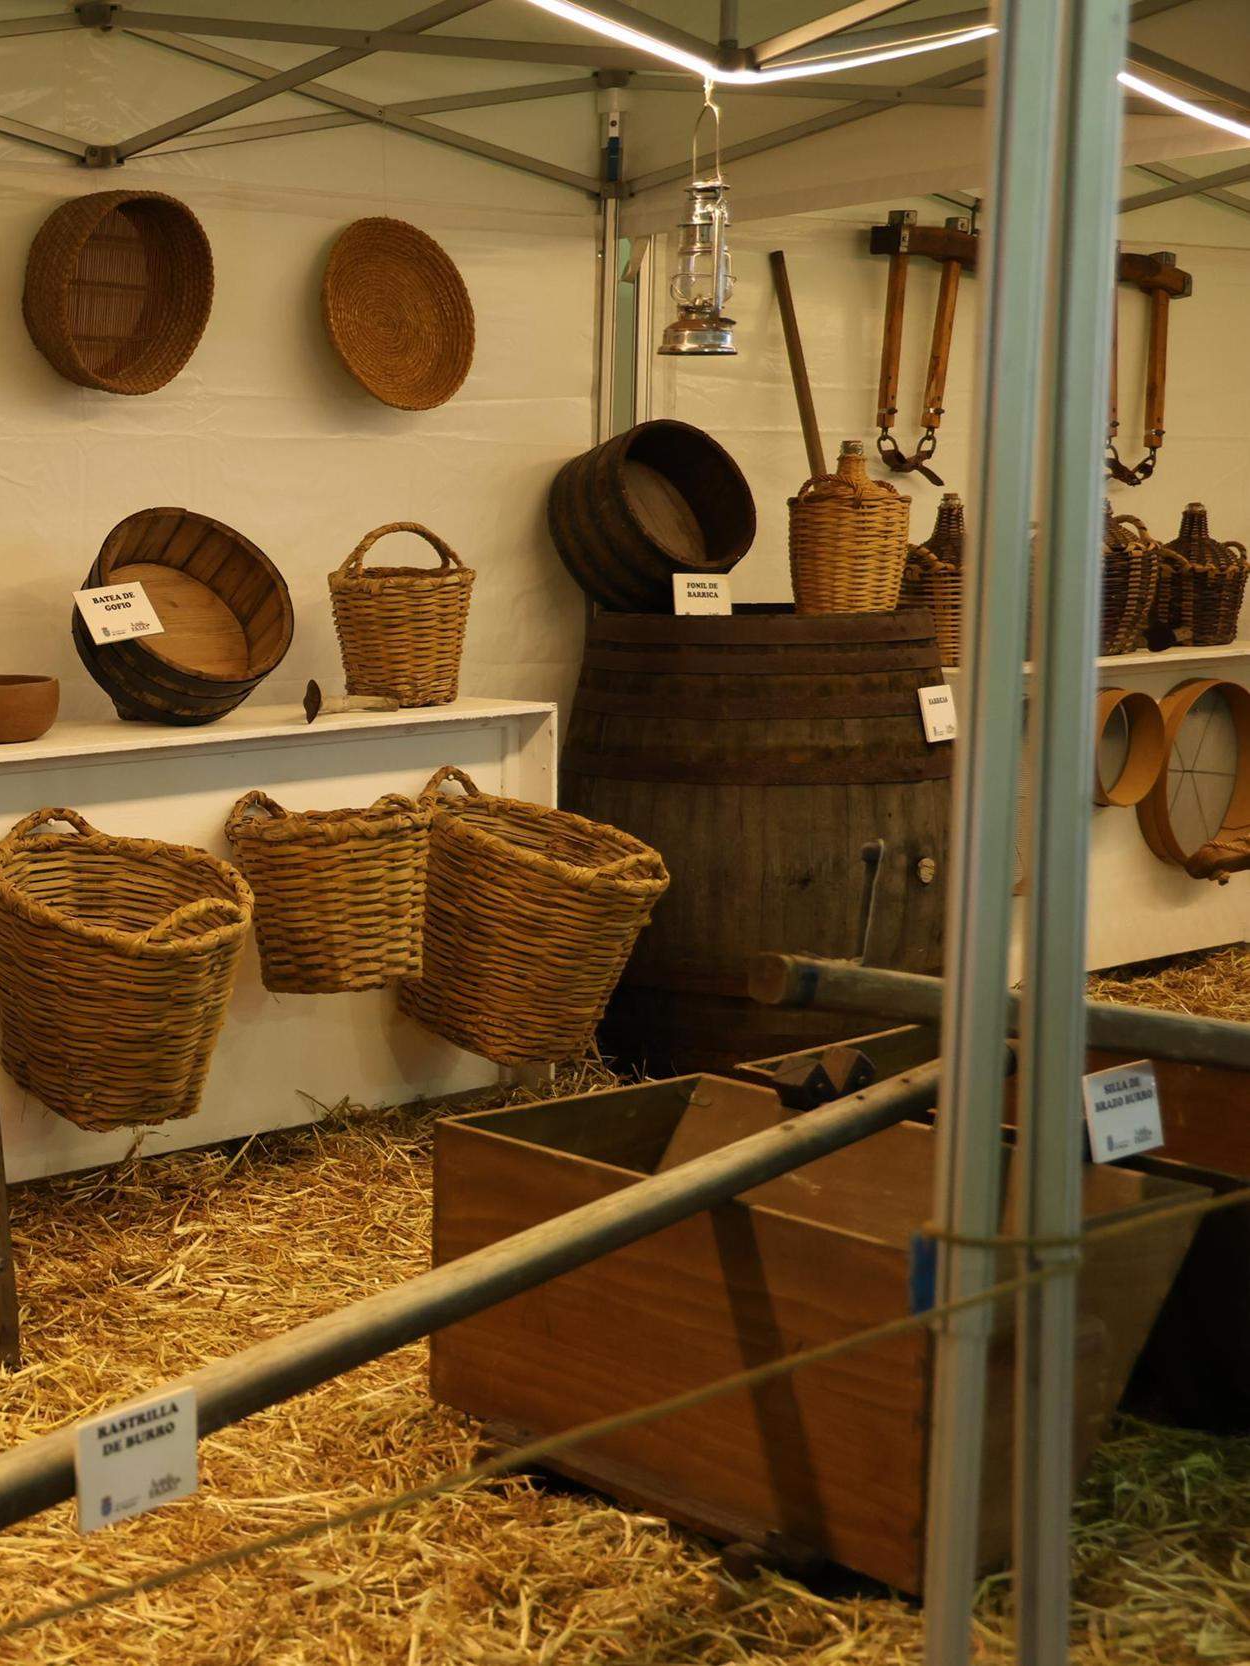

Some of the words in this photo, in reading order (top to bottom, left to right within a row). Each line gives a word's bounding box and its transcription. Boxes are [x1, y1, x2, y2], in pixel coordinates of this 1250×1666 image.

[708, 582, 719, 590] DE
[91, 594, 122, 605] BATEA
[122, 591, 136, 600] DE
[687, 590, 719, 599] BARRICA
[104, 601, 132, 612] GOFIO
[97, 1402, 180, 1440] RASTRILLA
[102, 1440, 123, 1457] DE
[125, 1421, 176, 1449] BURRO
